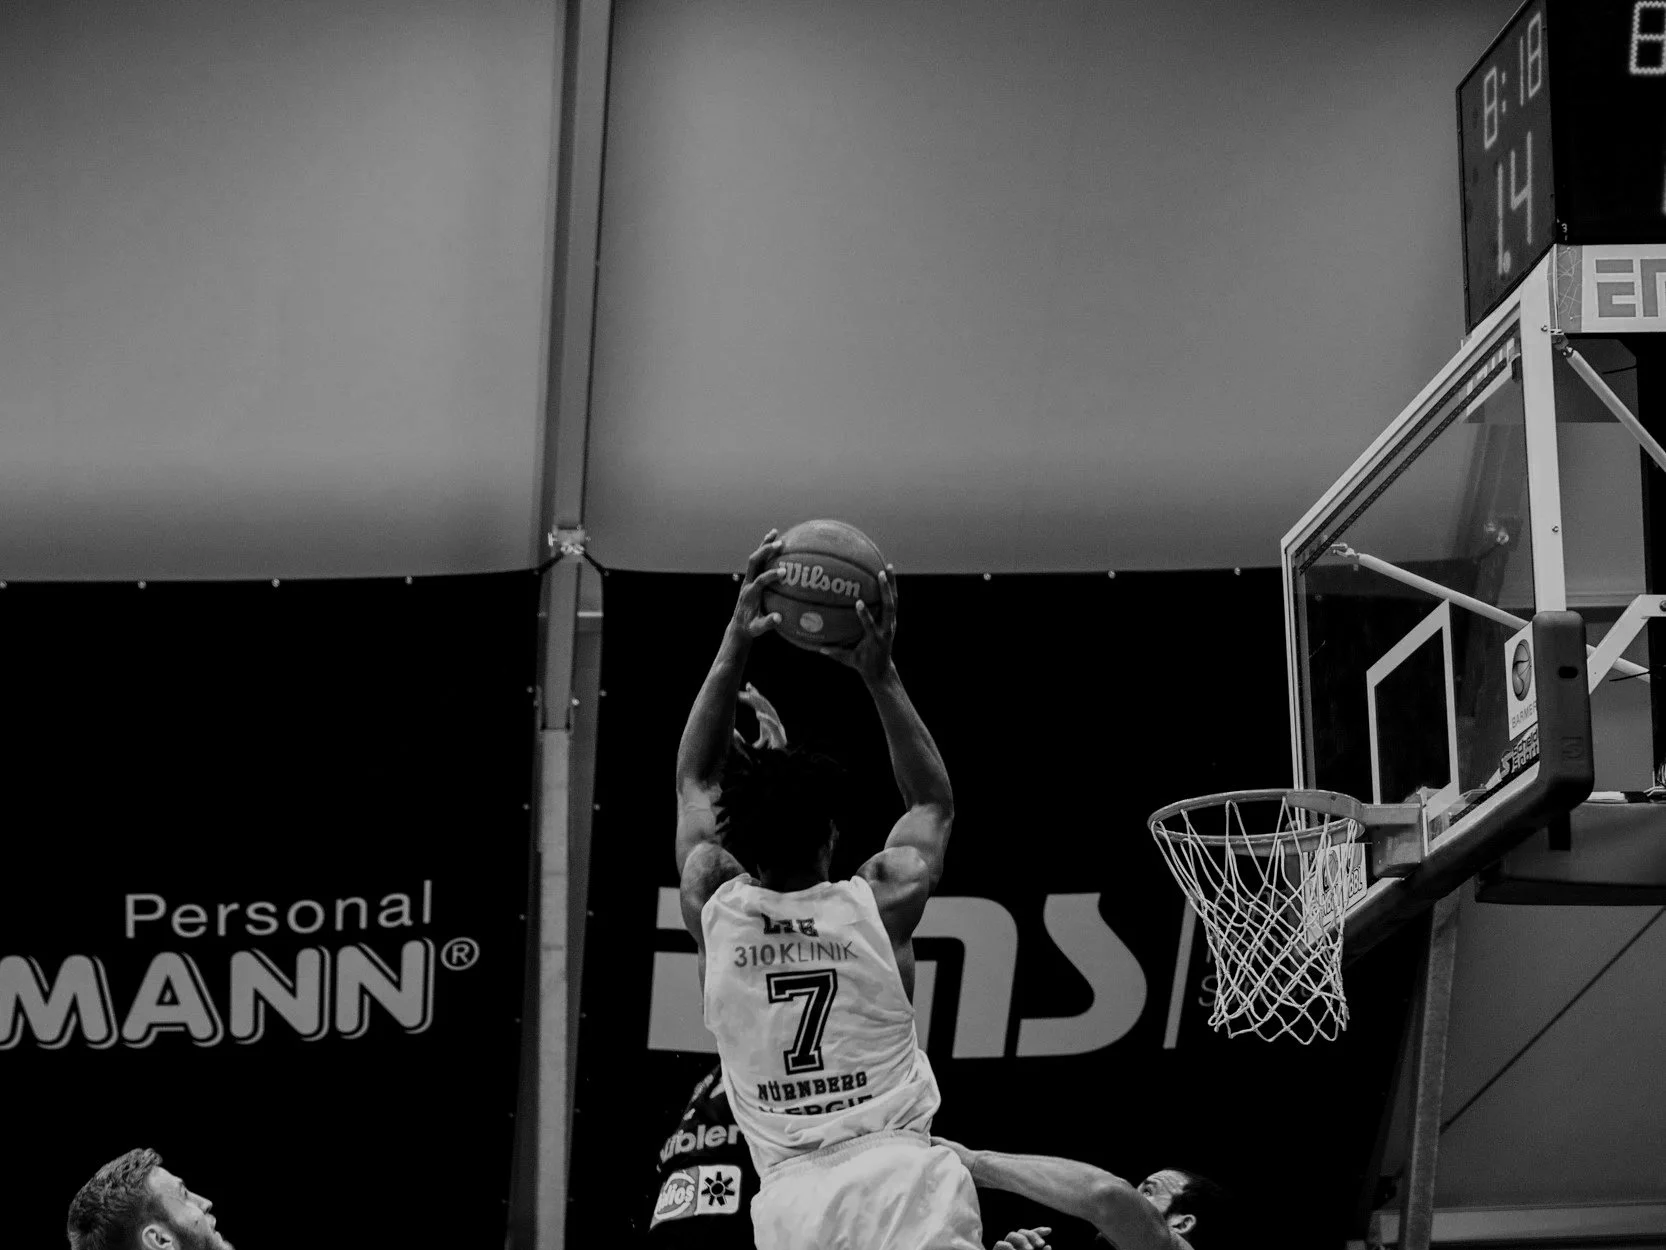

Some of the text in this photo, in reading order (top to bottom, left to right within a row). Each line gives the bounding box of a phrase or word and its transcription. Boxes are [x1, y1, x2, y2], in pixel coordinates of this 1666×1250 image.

[1482, 10, 1542, 151] 8:18
[778, 561, 861, 600] Wilson
[124, 878, 434, 940] Personal
[766, 968, 838, 1076] 7
[757, 1071, 868, 1102] NÜRNBERG
